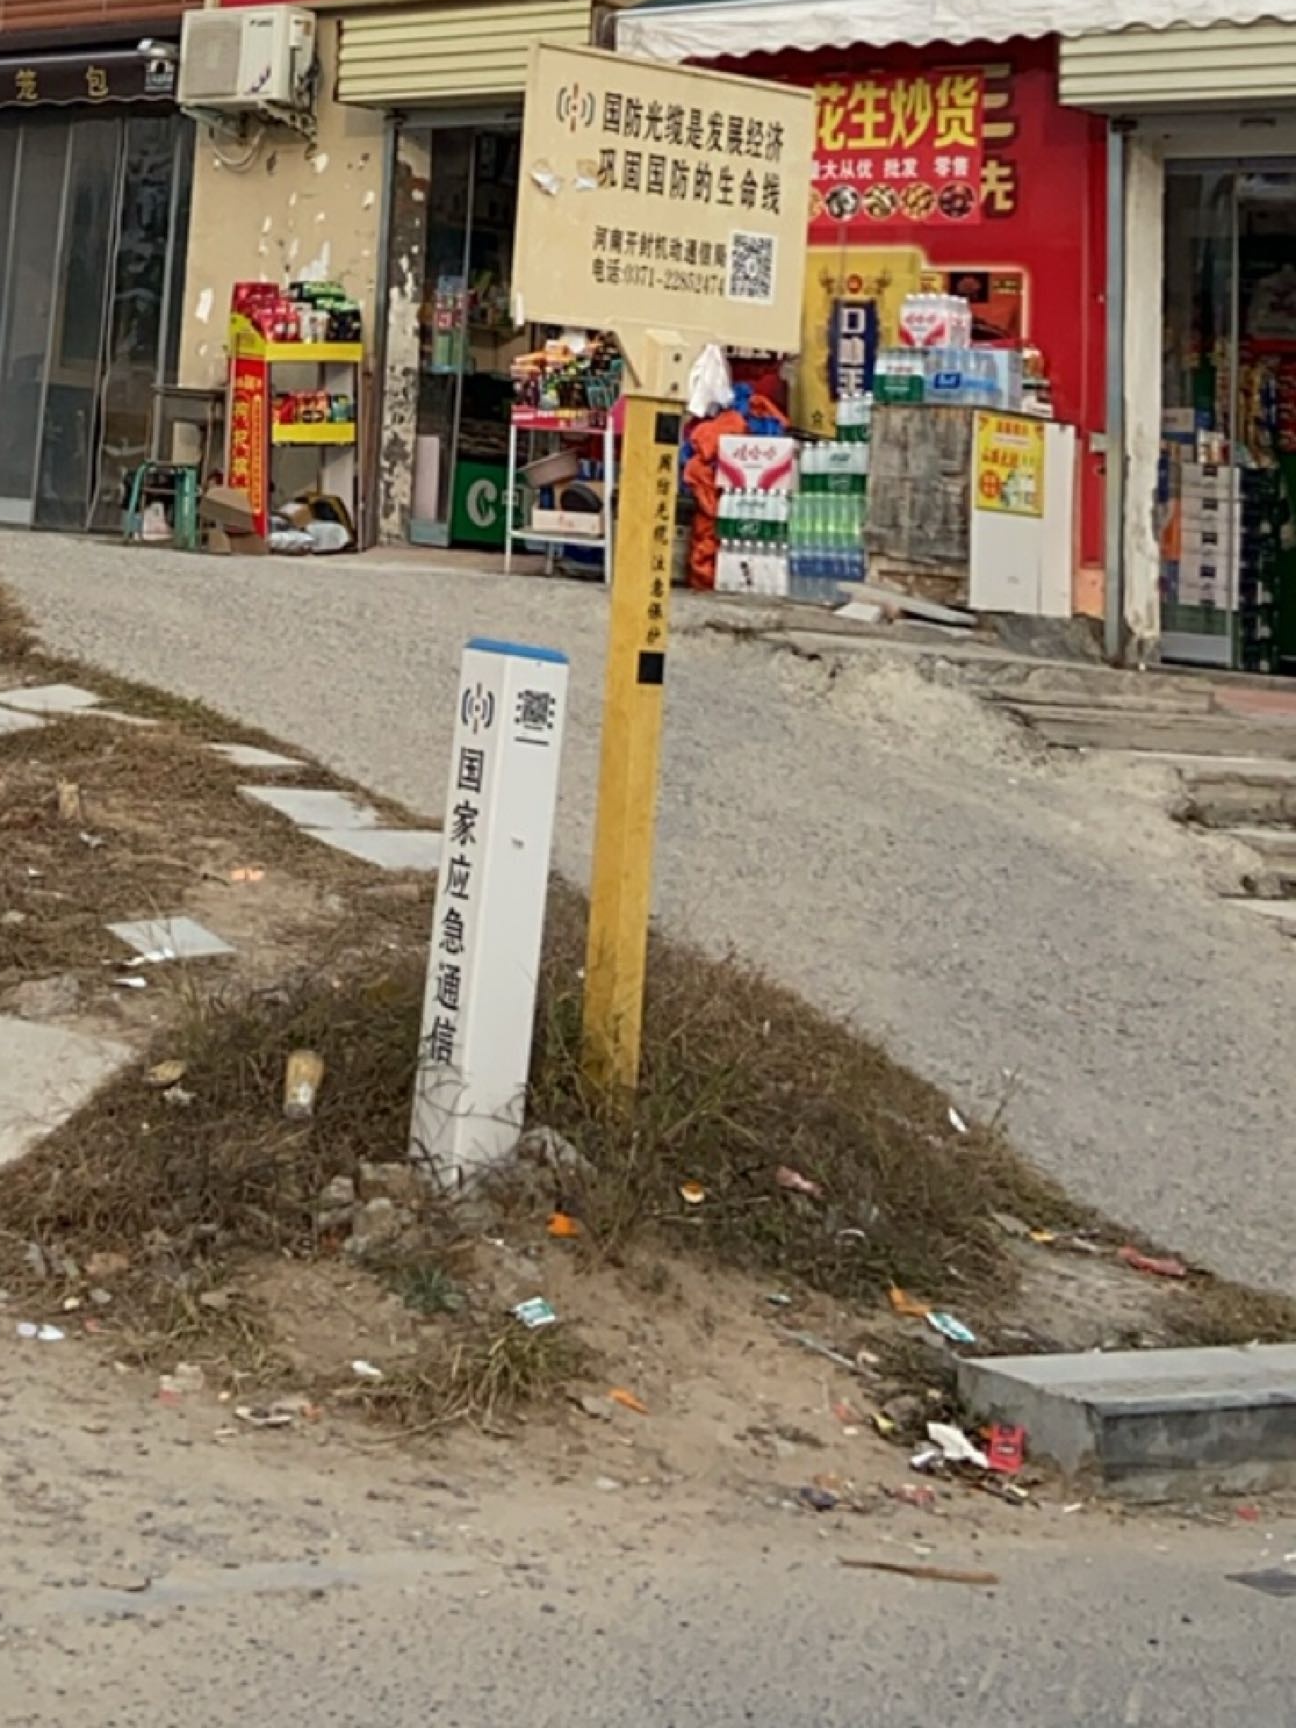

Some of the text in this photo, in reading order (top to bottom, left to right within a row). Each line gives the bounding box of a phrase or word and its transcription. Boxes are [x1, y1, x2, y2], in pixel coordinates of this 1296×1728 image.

[601, 91, 784, 162] 国防光缆是发展经济
[814, 73, 979, 151] 花生炒货
[597, 148, 781, 215] 巩固国防的生命线
[430, 747, 485, 1065] 国家应急通信
